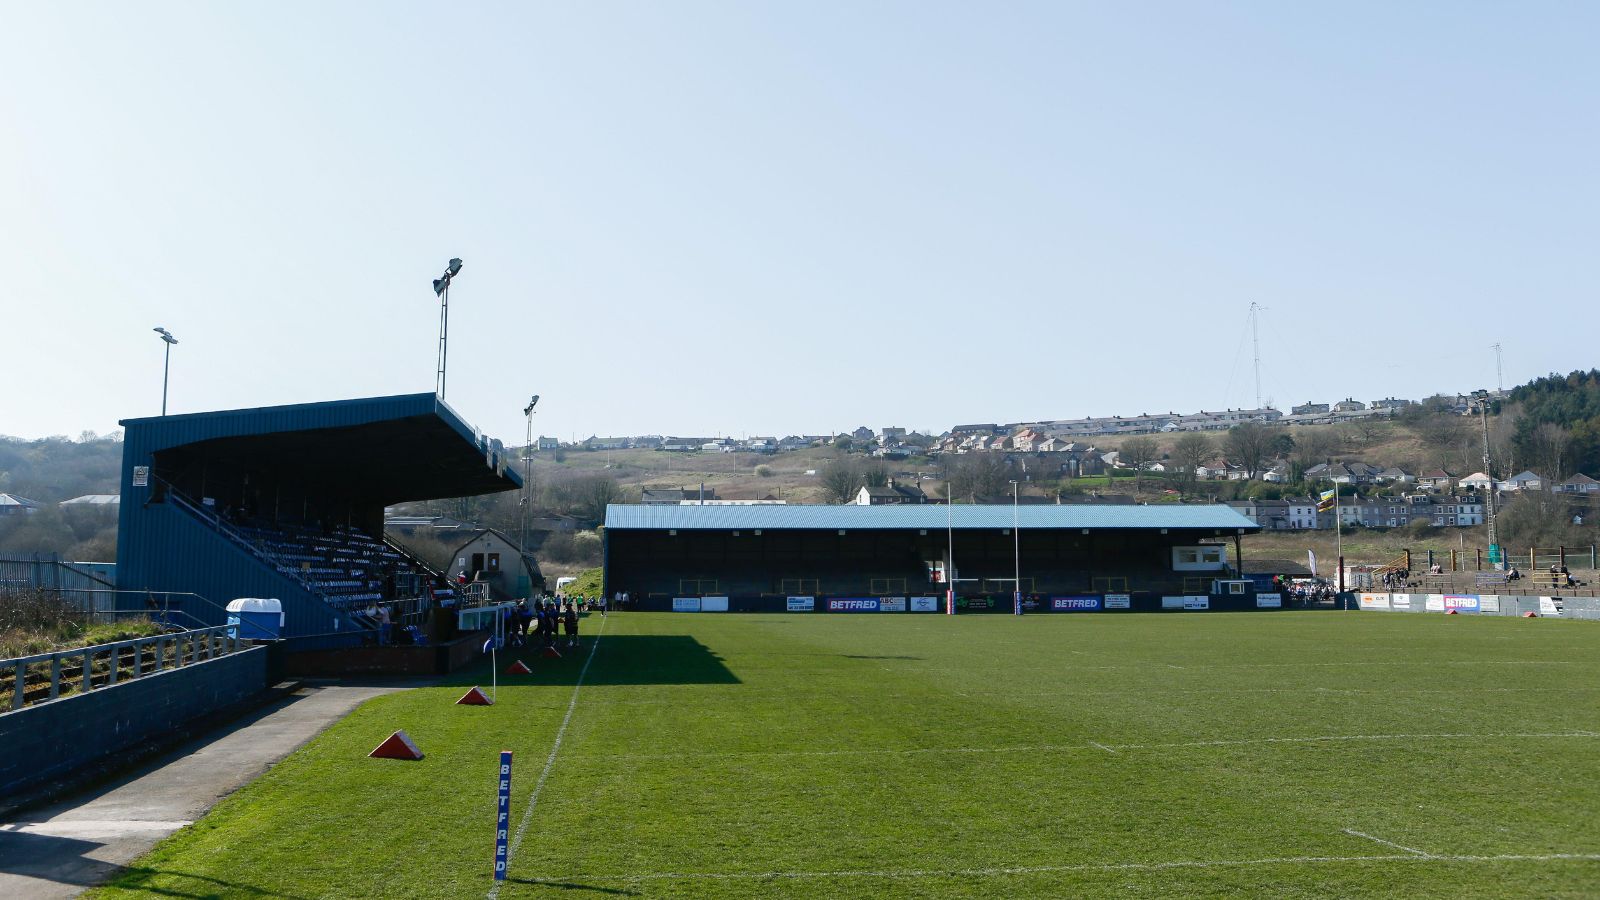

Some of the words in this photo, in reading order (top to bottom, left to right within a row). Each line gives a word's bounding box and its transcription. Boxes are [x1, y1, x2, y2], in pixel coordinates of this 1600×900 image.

[830, 600, 877, 609] BETFRED
[1054, 599, 1098, 608] BETFRED
[1445, 598, 1477, 608] BETFRED
[495, 764, 510, 871] BETFRED
